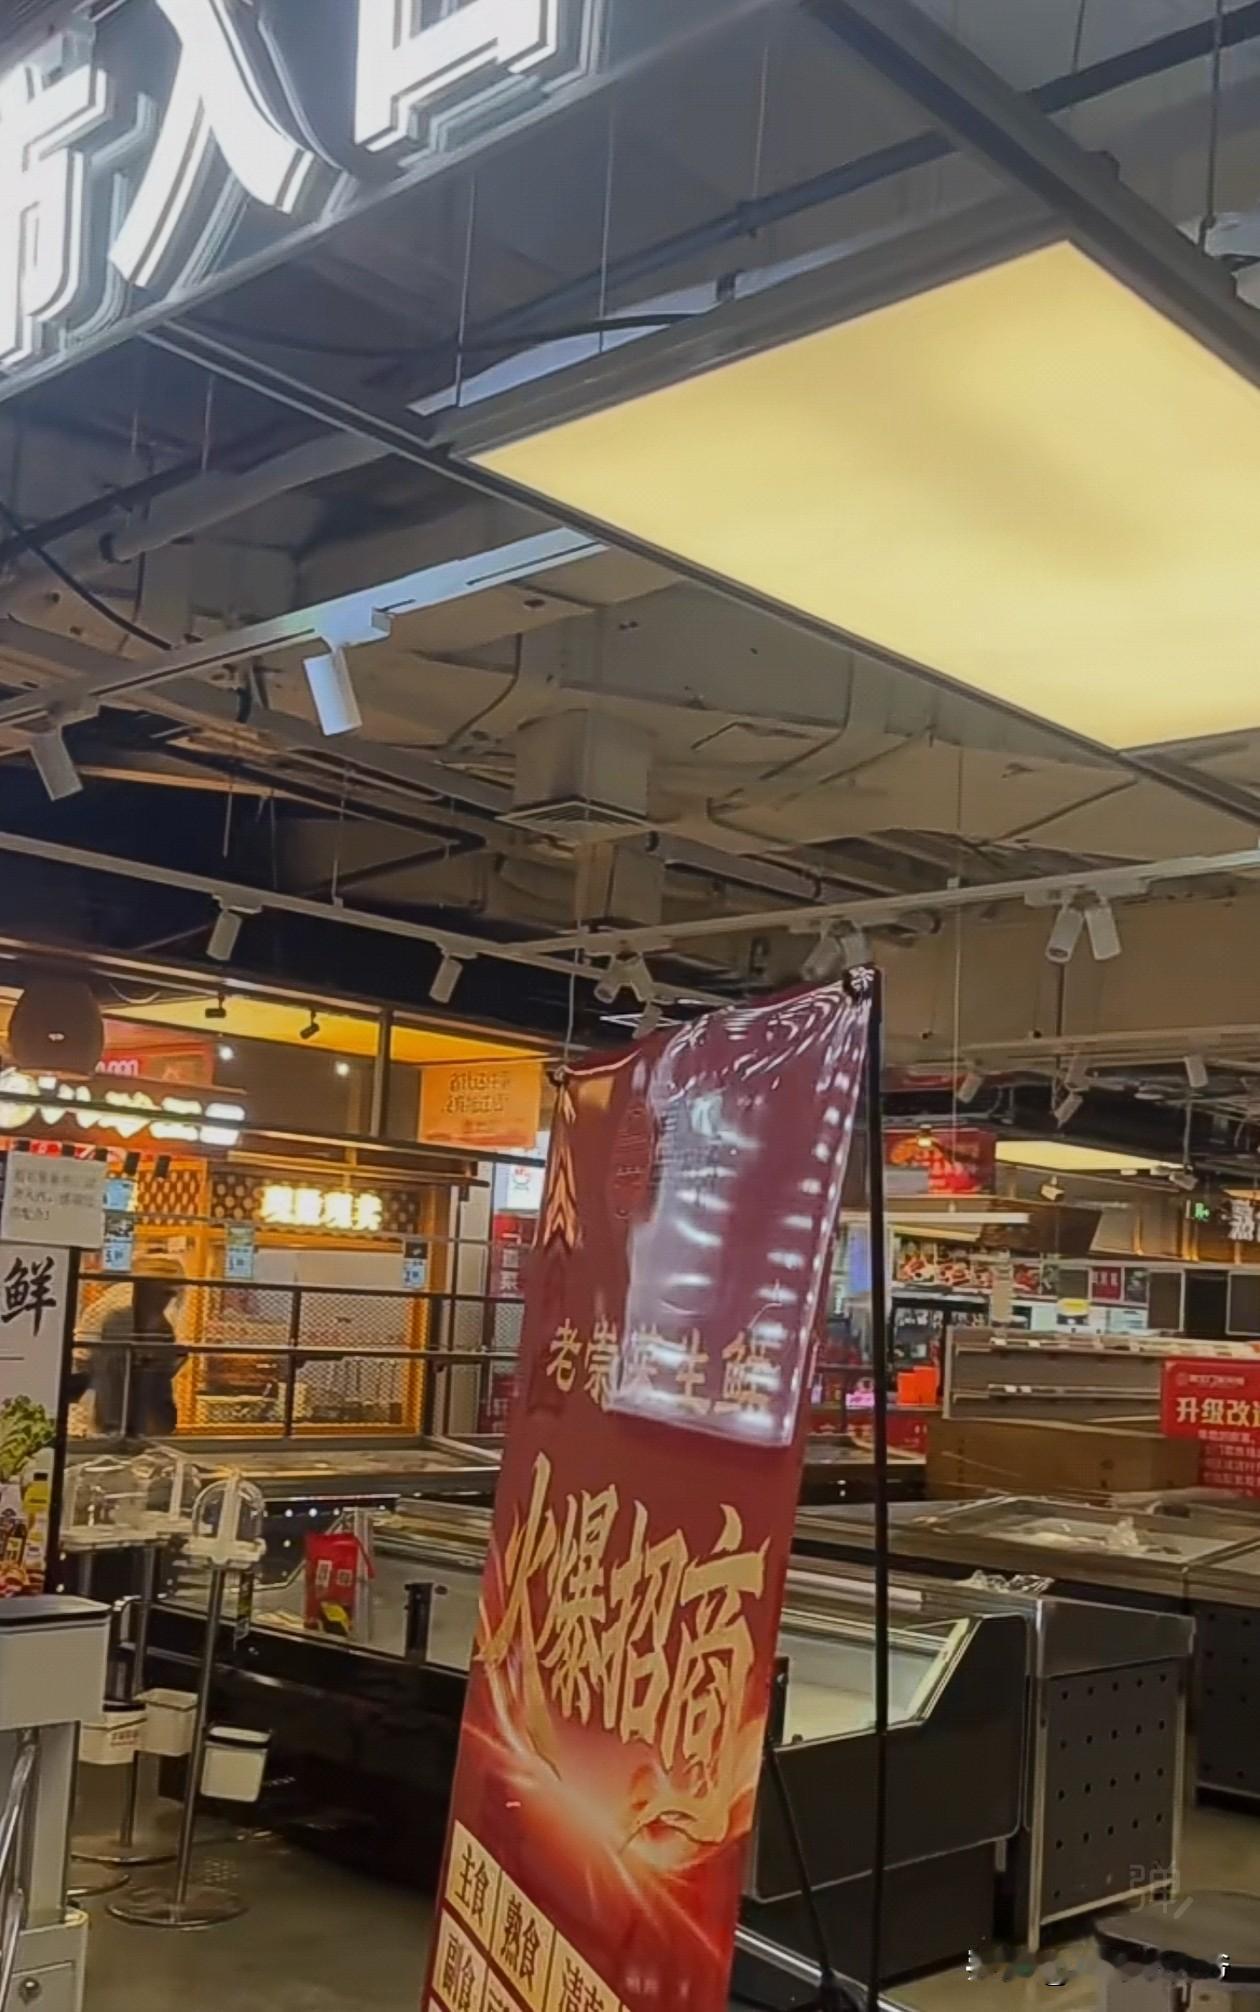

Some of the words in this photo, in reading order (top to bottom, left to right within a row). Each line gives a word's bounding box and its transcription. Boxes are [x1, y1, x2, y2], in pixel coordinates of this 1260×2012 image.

[1, 1257, 57, 1337] 鲜
[1175, 1396, 1260, 1429] 升级改
[475, 1450, 771, 1842] 火爆招商
[454, 1843, 490, 1928] 主食
[500, 1893, 541, 1993] 熟食
